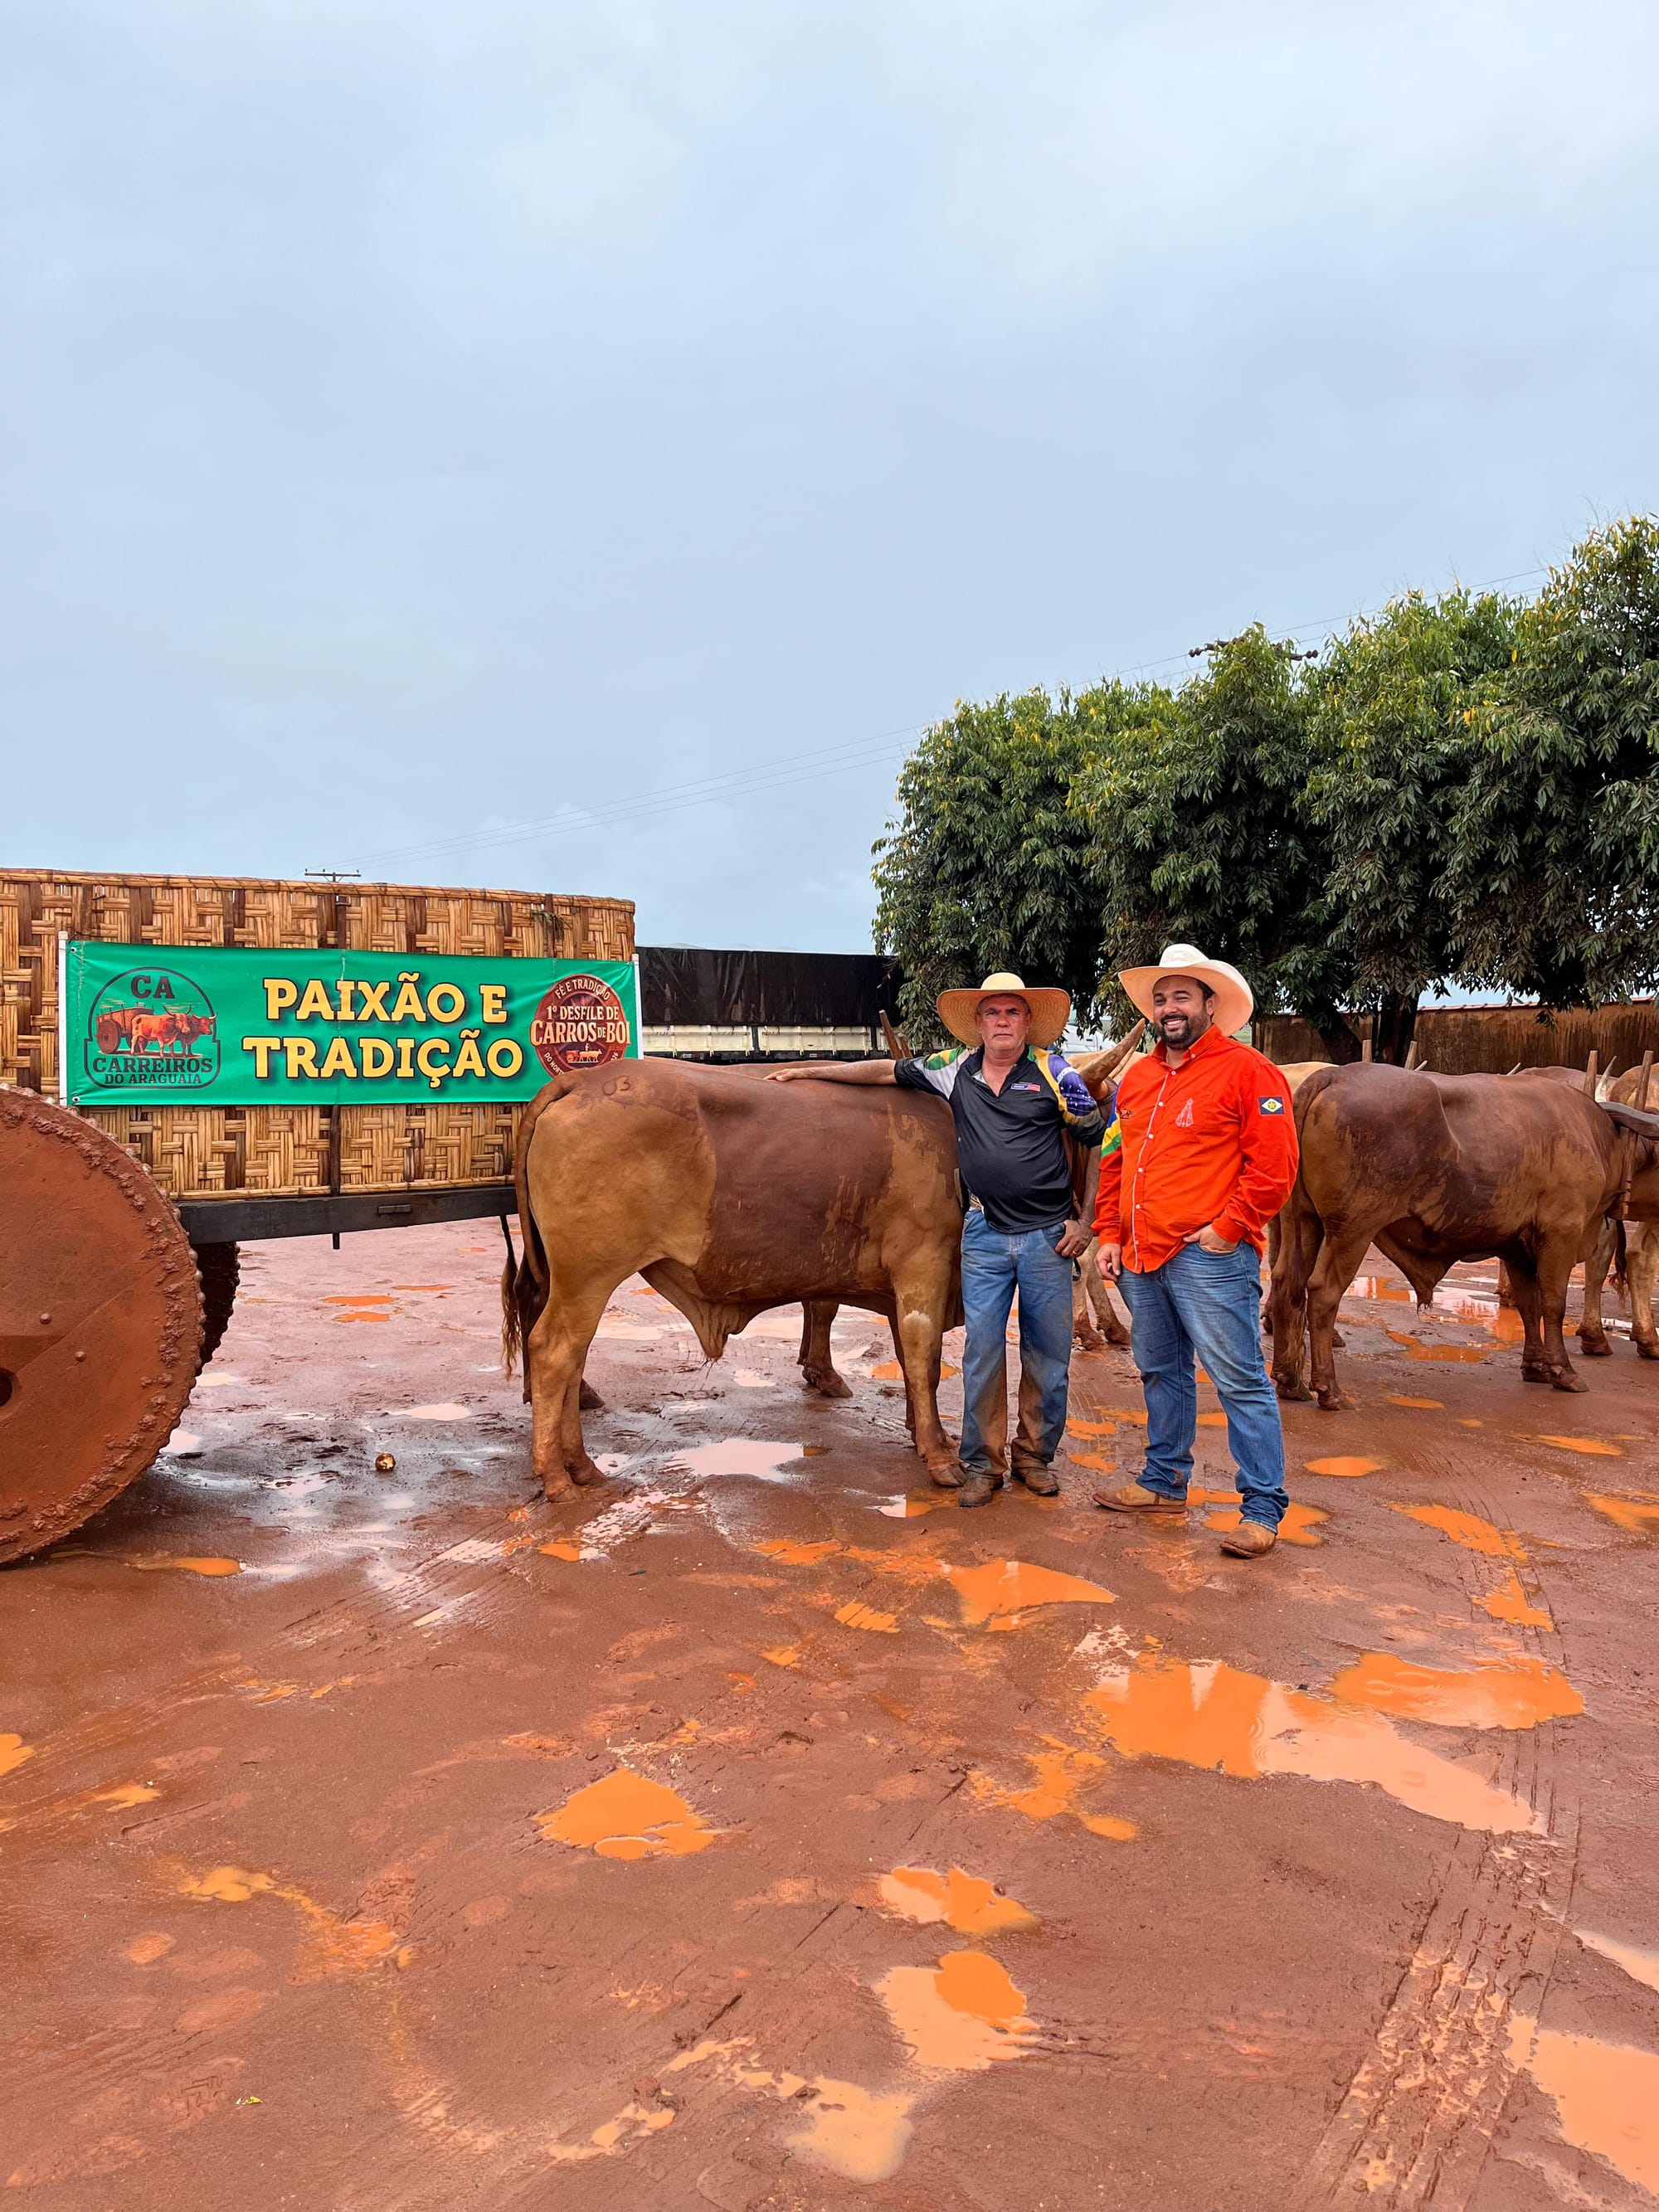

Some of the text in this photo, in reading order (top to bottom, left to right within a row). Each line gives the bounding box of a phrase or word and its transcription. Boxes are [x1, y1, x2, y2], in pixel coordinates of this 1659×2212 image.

[130, 975, 175, 999] CA
[565, 981, 572, 992] E
[263, 971, 508, 1023] PAIXÃO E
[559, 1005, 604, 1020] DESFILE
[606, 1005, 620, 1020] DE
[530, 1019, 630, 1046] CARROS DE BOI
[92, 1057, 213, 1073] CARREIROS
[242, 1028, 523, 1089] TRADIÇÃO
[549, 1061, 565, 1076] NORT
[105, 1074, 202, 1084] DO ARAGUAIA
